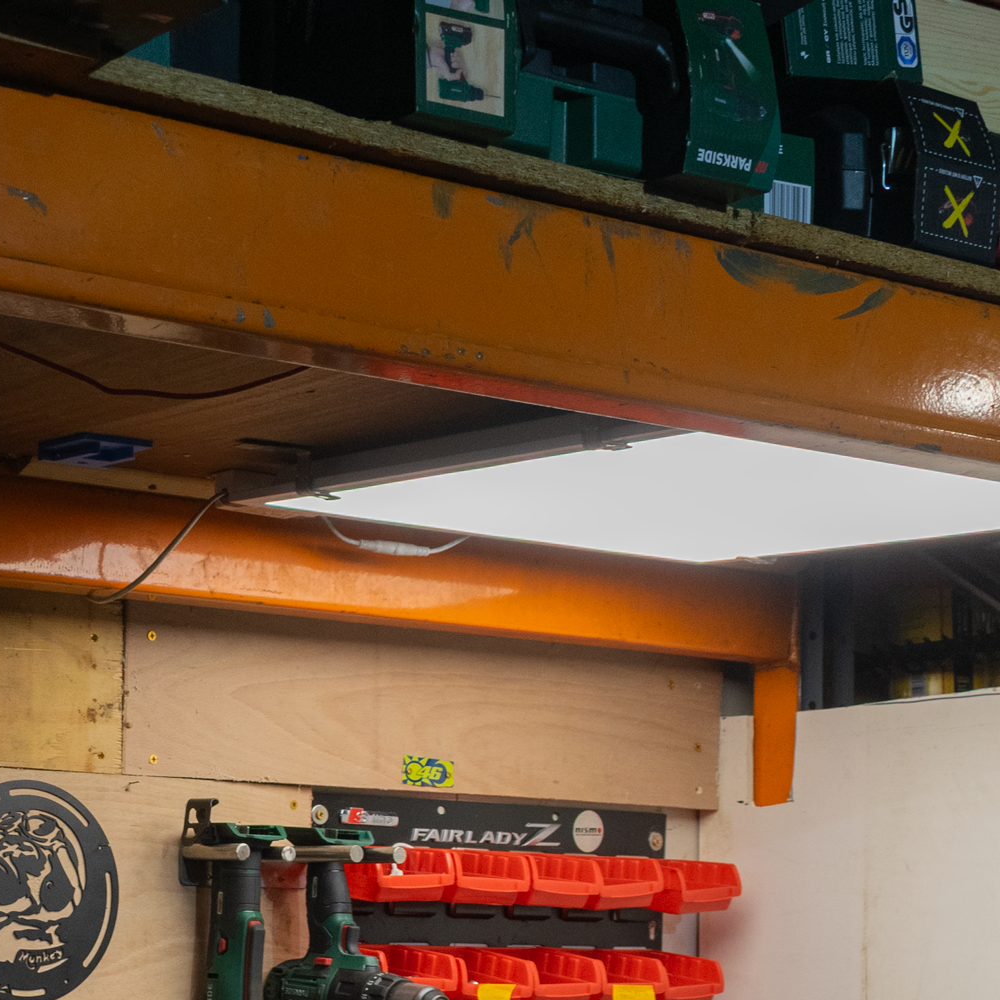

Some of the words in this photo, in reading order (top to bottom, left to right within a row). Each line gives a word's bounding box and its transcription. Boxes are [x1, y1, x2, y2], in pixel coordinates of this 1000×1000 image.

[697, 148, 752, 172] PARKSIDE
[416, 766, 443, 780] 46
[410, 827, 527, 846] FAIRLADY
[521, 823, 561, 847] Z
